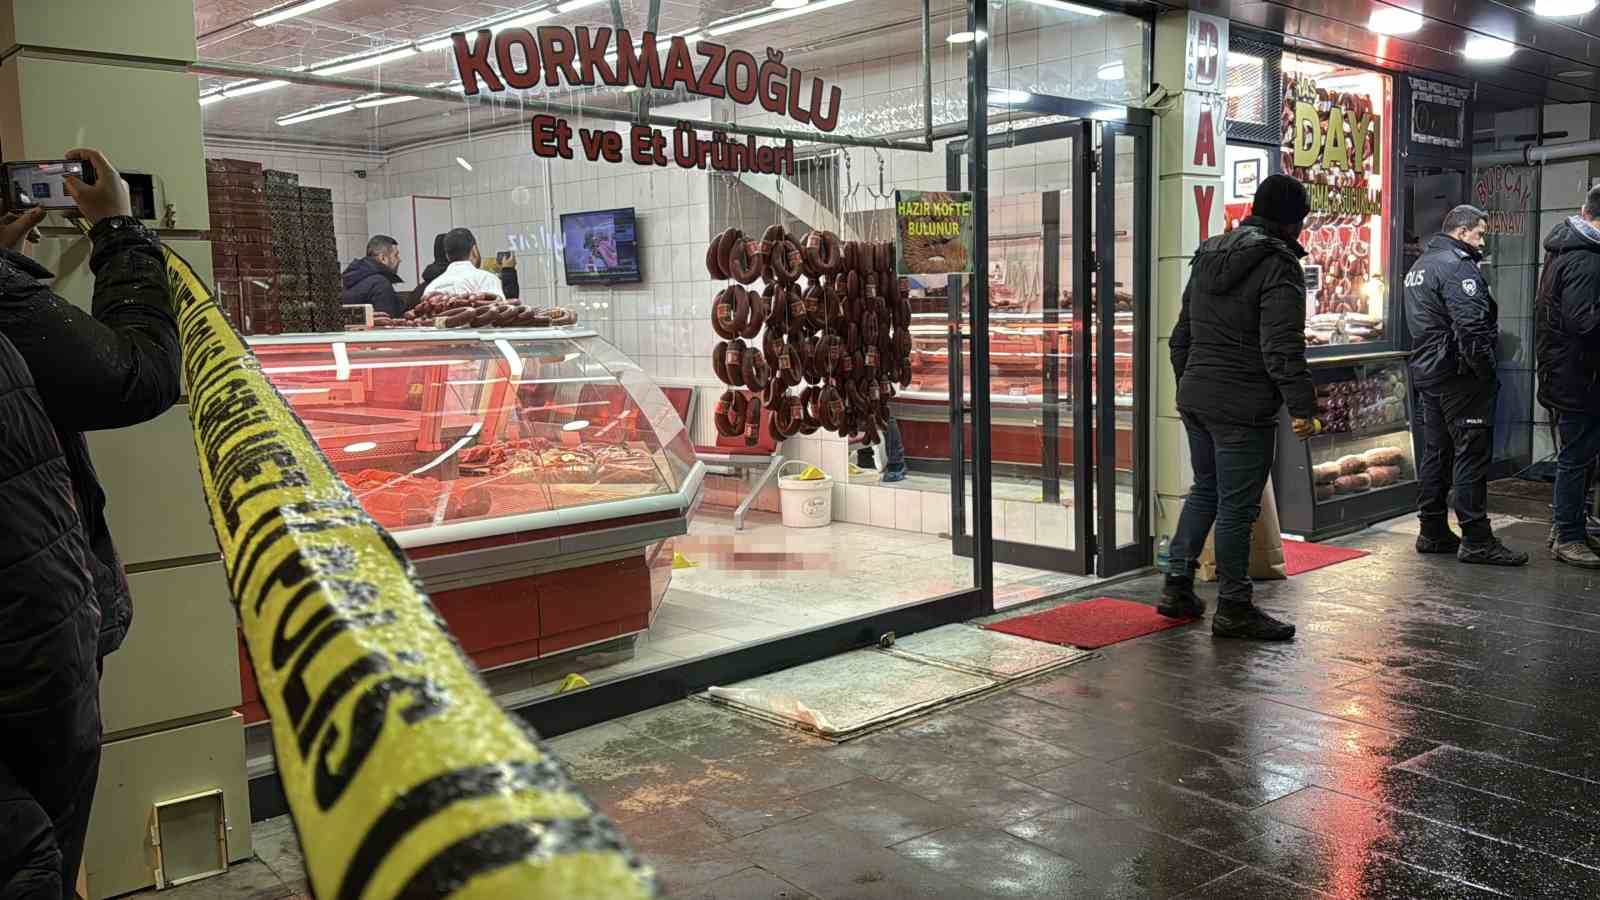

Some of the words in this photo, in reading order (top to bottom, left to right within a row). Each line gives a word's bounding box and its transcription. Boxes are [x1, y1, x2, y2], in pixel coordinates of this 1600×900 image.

[451, 26, 841, 132] KORKMAZOĞLU
[532, 114, 573, 160] Et
[579, 128, 623, 163] ve
[631, 123, 668, 167] Et
[673, 121, 795, 177] Ürünleri
[1294, 101, 1381, 175] DAYI
[898, 202, 930, 216] HAZIR
[908, 222, 960, 236] BULUNUR
